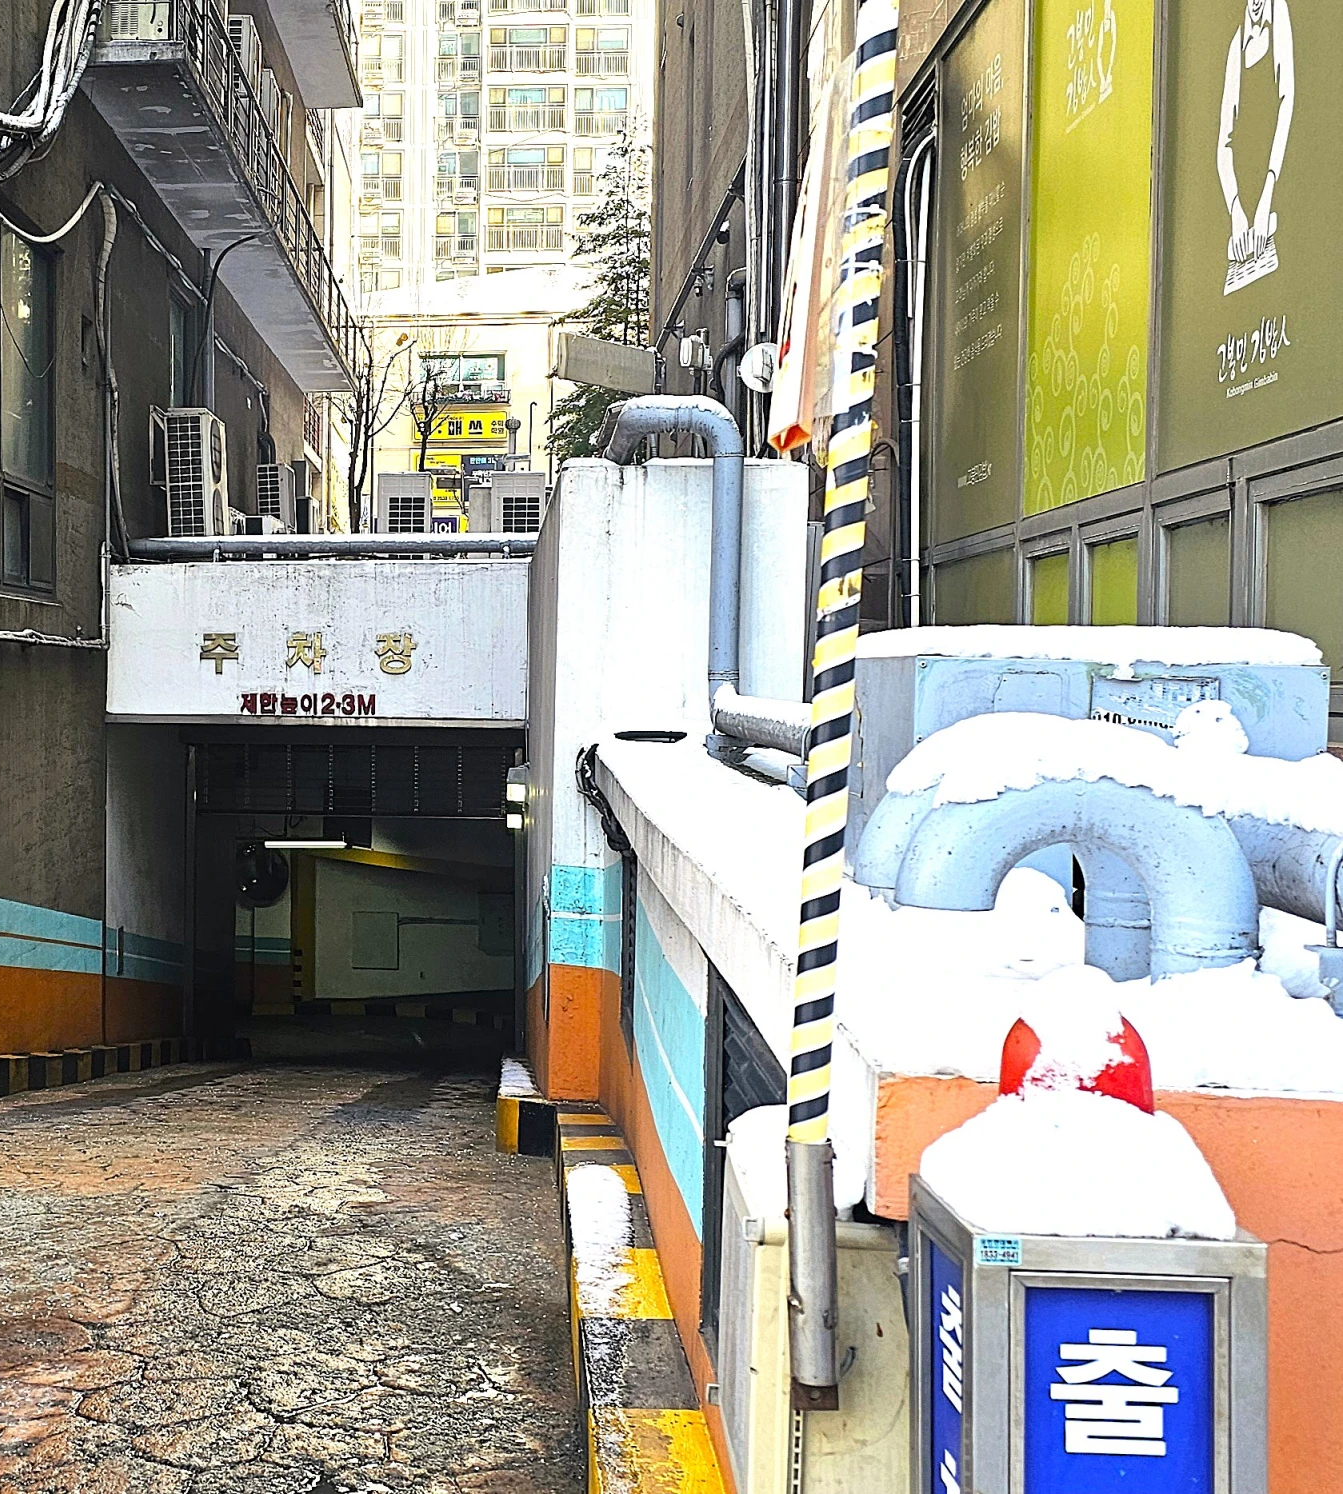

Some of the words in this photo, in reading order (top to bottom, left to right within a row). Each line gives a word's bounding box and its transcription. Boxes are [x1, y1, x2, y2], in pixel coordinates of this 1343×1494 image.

[960, 73, 985, 133] 엄마의
[960, 125, 982, 181] 행복한
[984, 104, 1002, 156] 김밥
[199, 632, 417, 675] 주차장
[1050, 1328, 1180, 1457] 출
